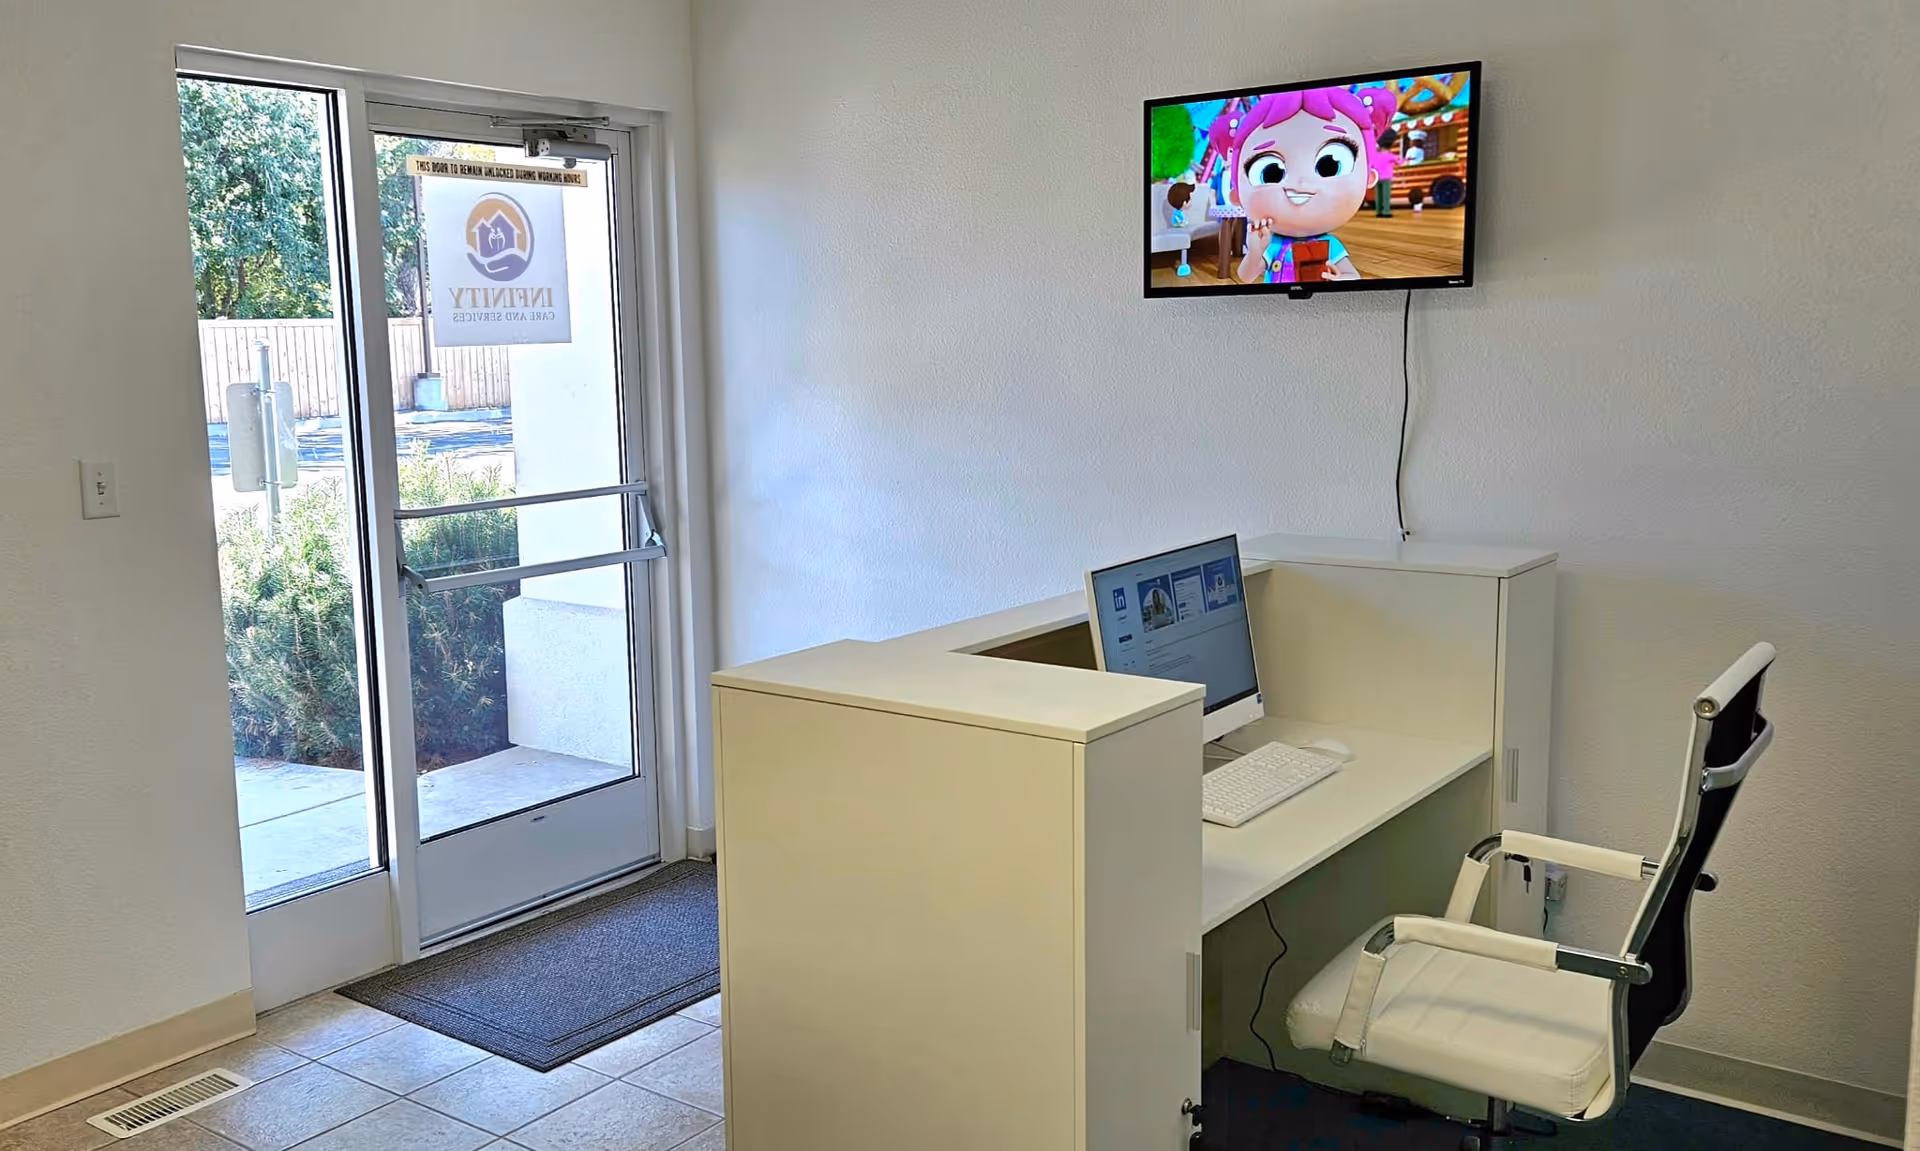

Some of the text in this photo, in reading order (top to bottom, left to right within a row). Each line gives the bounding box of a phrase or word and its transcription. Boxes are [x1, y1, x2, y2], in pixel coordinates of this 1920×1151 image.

[415, 160, 581, 184] THIS DOOR TO REMAIN UNLOCKED DURING WORKING HOURS
